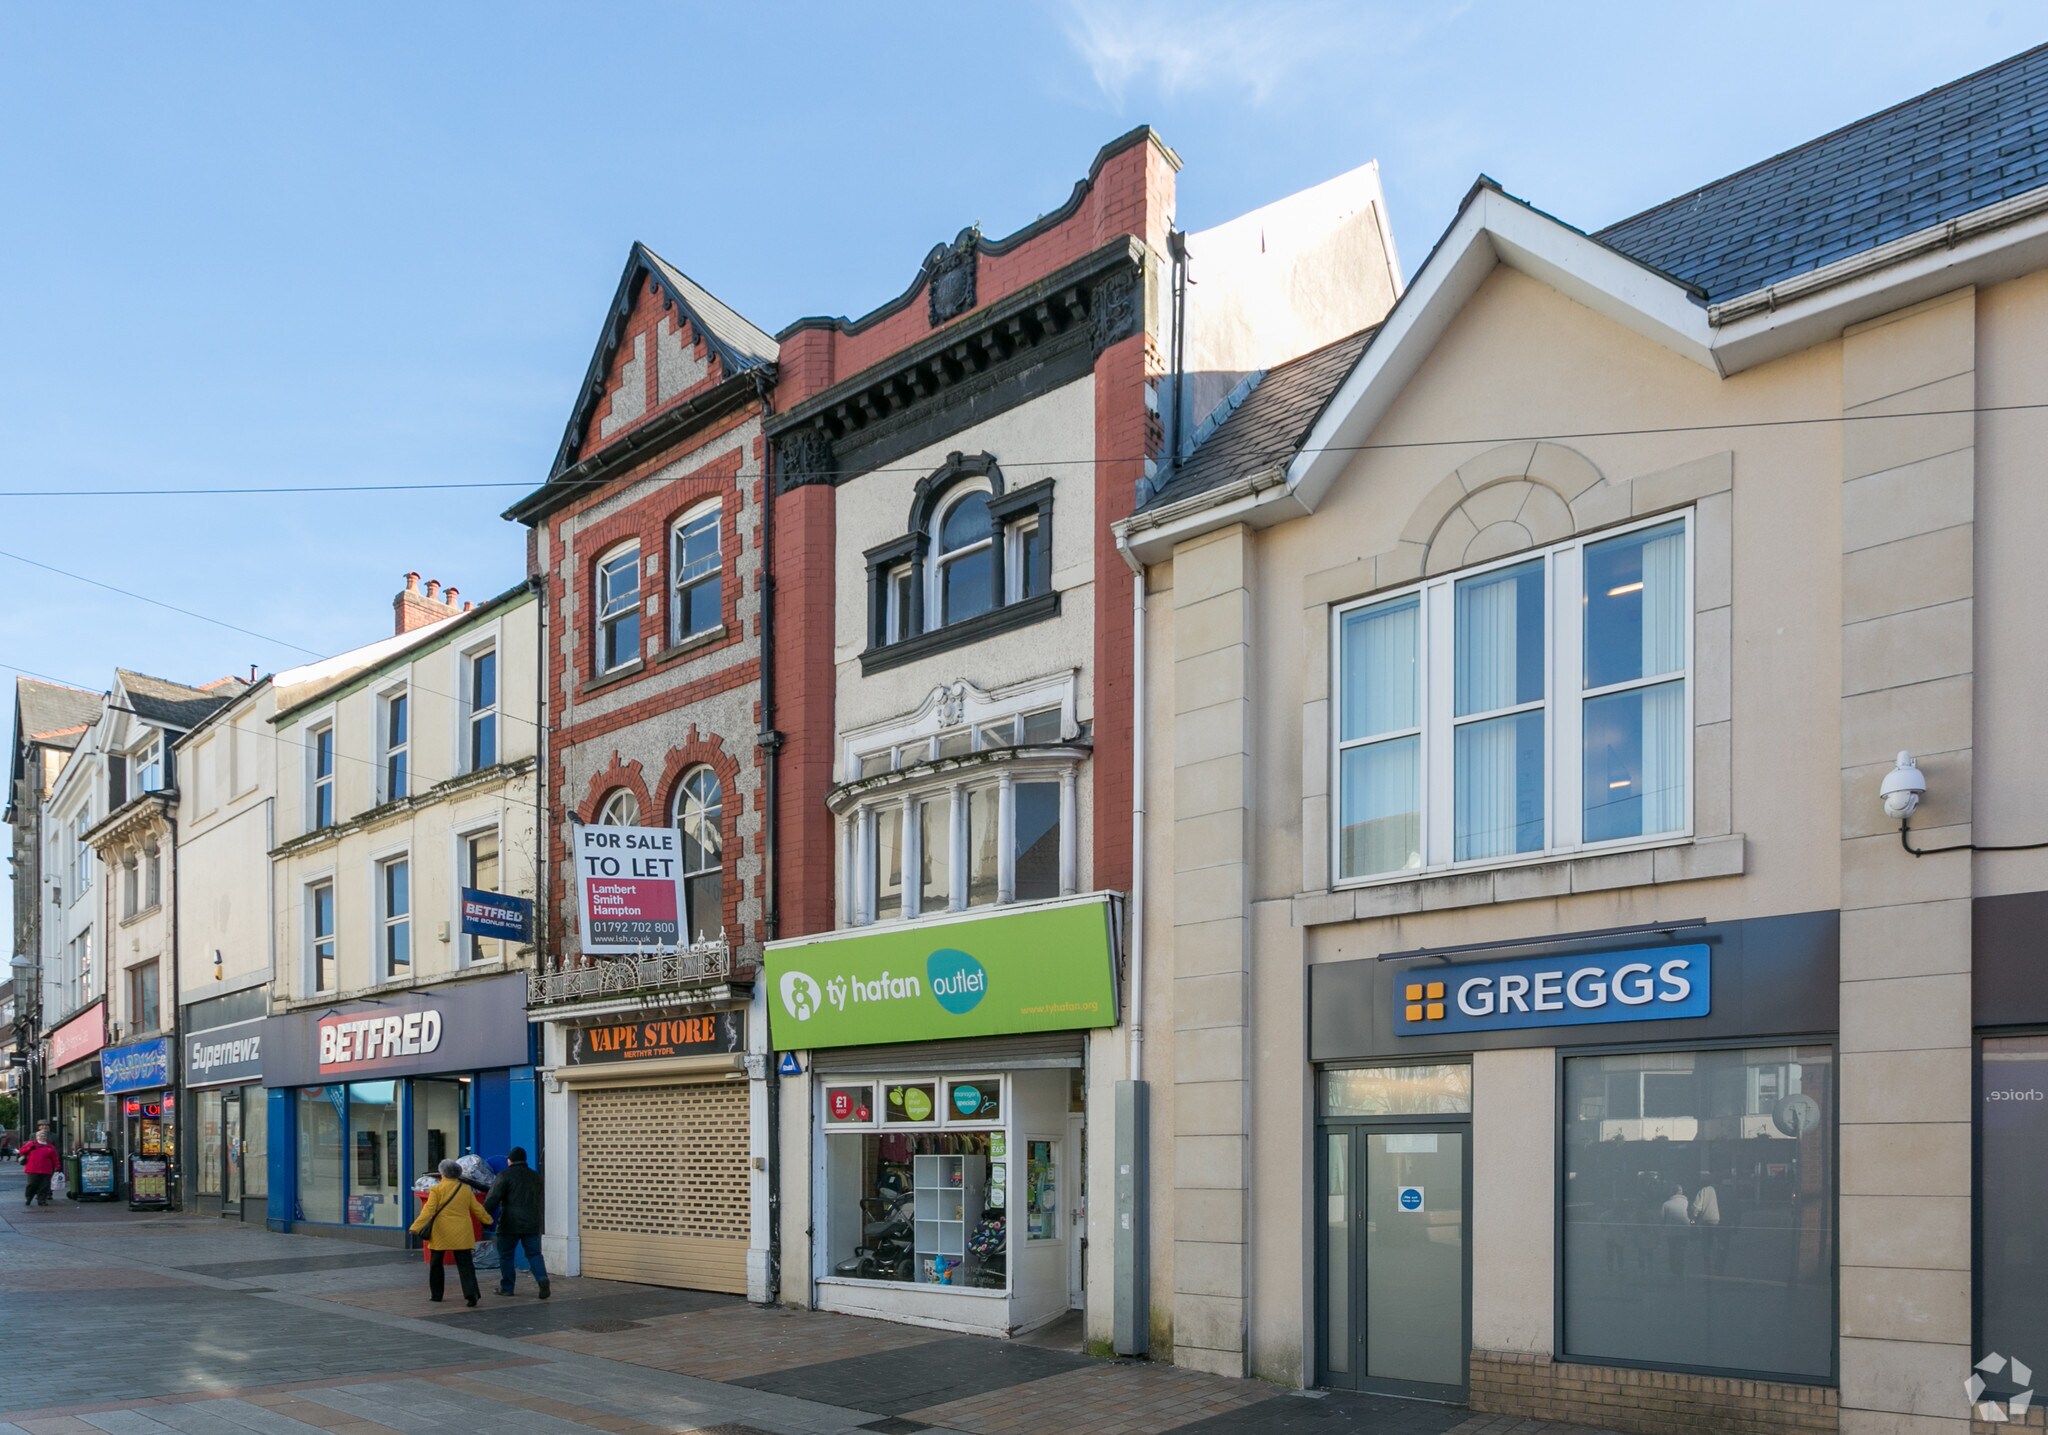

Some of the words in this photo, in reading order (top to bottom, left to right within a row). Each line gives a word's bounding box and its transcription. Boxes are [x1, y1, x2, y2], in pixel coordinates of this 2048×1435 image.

[584, 832, 621, 848] FOR
[626, 834, 673, 850] SALE
[584, 856, 620, 876] TO
[632, 858, 674, 877] LET
[592, 883, 636, 894] Lambert
[593, 894, 624, 905] Smith
[466, 903, 523, 922] BETFRED
[593, 905, 641, 917] Hampton
[466, 915, 479, 923] THE
[480, 918, 505, 927] BONUS
[505, 922, 523, 930] KING
[594, 921, 628, 932] 01792
[631, 922, 652, 933] 702
[654, 922, 675, 933] 800
[933, 968, 983, 995] outlet
[1457, 959, 1690, 1016] GREGGS
[826, 975, 847, 1011] tŷ
[851, 971, 920, 1002] hafan
[319, 1010, 442, 1064] BETFRED
[589, 1025, 638, 1052] VAPE
[644, 1016, 716, 1047] STORE
[192, 1036, 260, 1074] Supernewz
[623, 1049, 652, 1058] MERTHYR
[653, 1047, 675, 1056] TYDFIL
[836, 1096, 847, 1108] £1
